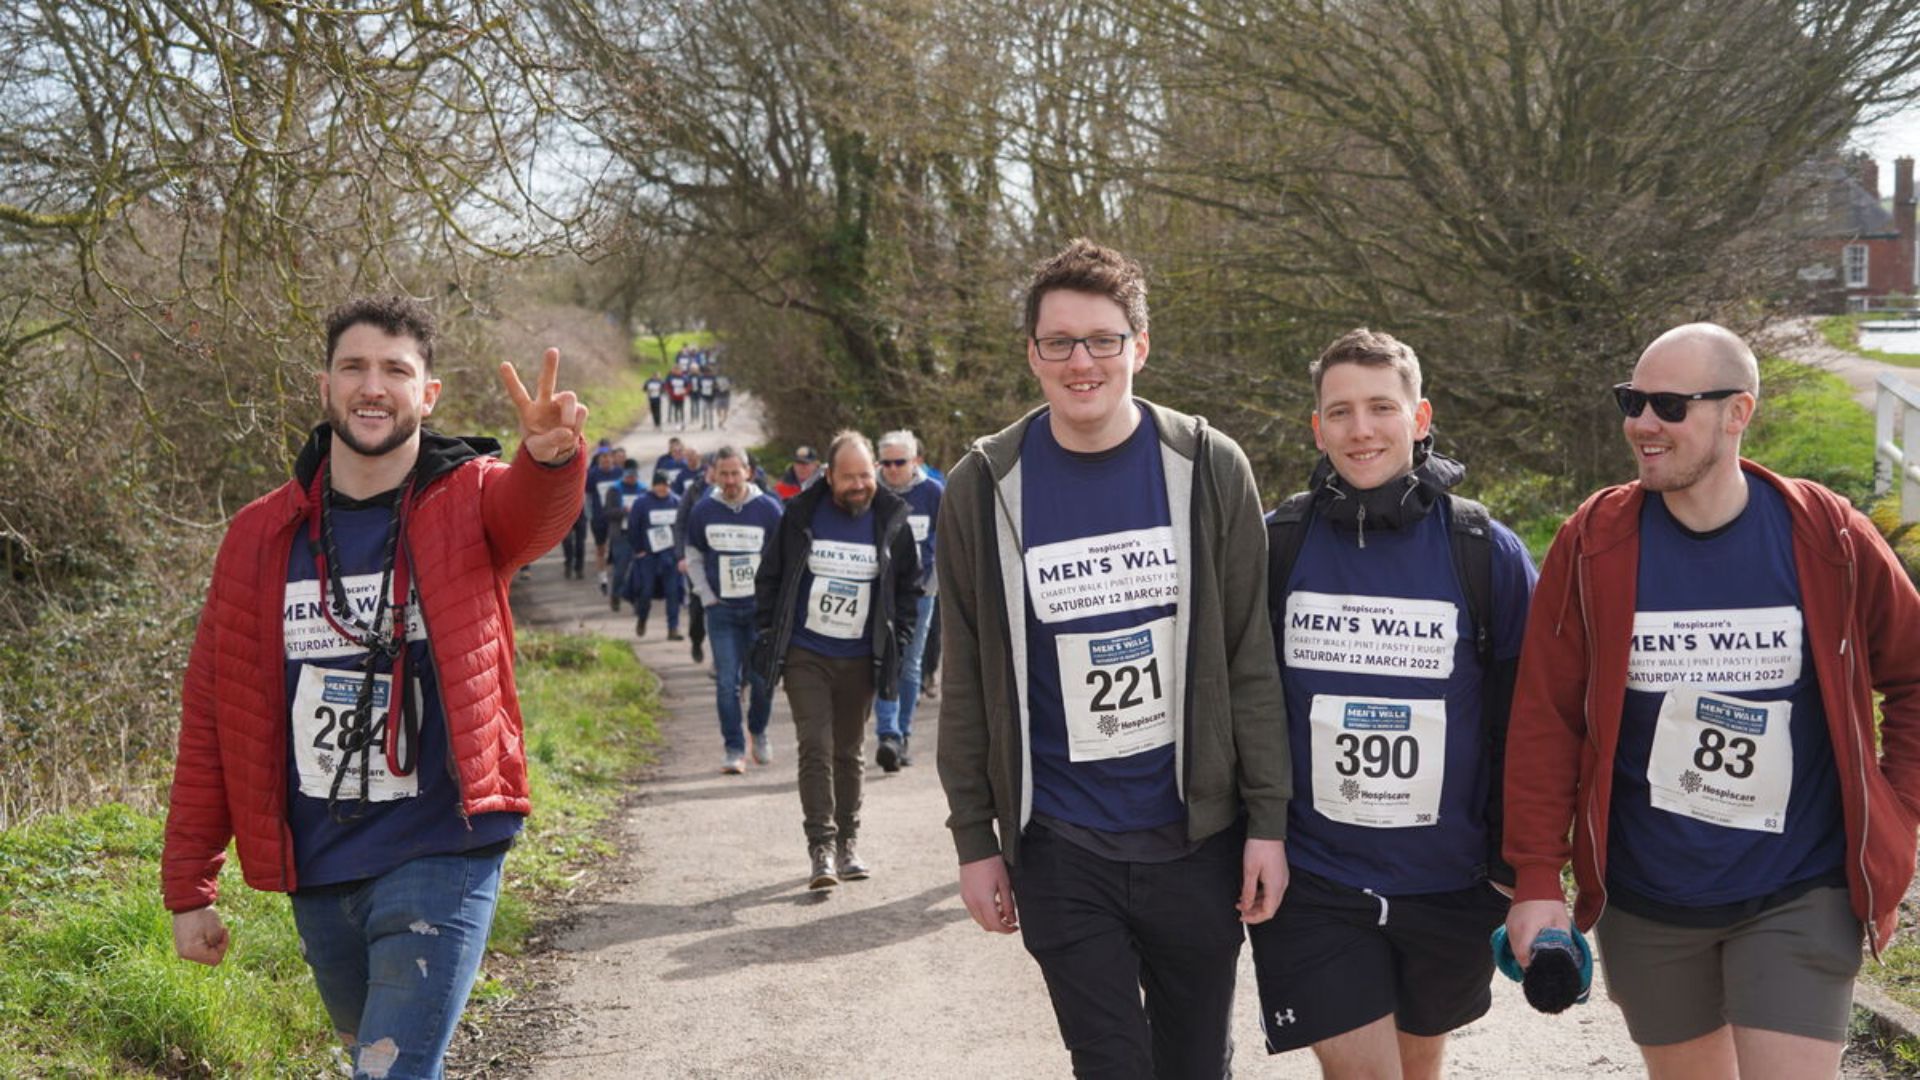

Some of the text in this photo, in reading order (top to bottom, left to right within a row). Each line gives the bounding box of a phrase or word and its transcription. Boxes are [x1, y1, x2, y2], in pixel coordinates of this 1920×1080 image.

[1088, 539, 1141, 555] Hospiscare's
[850, 553, 875, 564] WAL
[1038, 548, 1177, 584] MEN'S WAL
[729, 566, 755, 582] 199
[1079, 581, 1101, 594] WALK
[1135, 573, 1162, 584] PASTY
[819, 594, 858, 617] 674
[1049, 584, 1179, 614] SATURDAY 12 MARCH 20
[1342, 604, 1394, 615] Hospiscare's
[1291, 613, 1445, 639] MEN'S WALK
[1673, 619, 1732, 631] Hospiscare's
[287, 638, 335, 652] STURDAY
[1709, 630, 1788, 651] WALK
[1293, 648, 1440, 670] SATURDAY 12 MARCH 2022
[1723, 656, 1751, 666] PASTY
[1086, 657, 1162, 713] 221
[1627, 669, 1785, 683] SATURDAY 12 MARCH 2022
[313, 706, 389, 755] 284
[1121, 711, 1166, 730] Hospiscare
[1335, 733, 1420, 779] 390
[1693, 728, 1757, 779] 83
[1361, 790, 1410, 801] Hospiscare
[1702, 784, 1756, 802] Hospiscare
